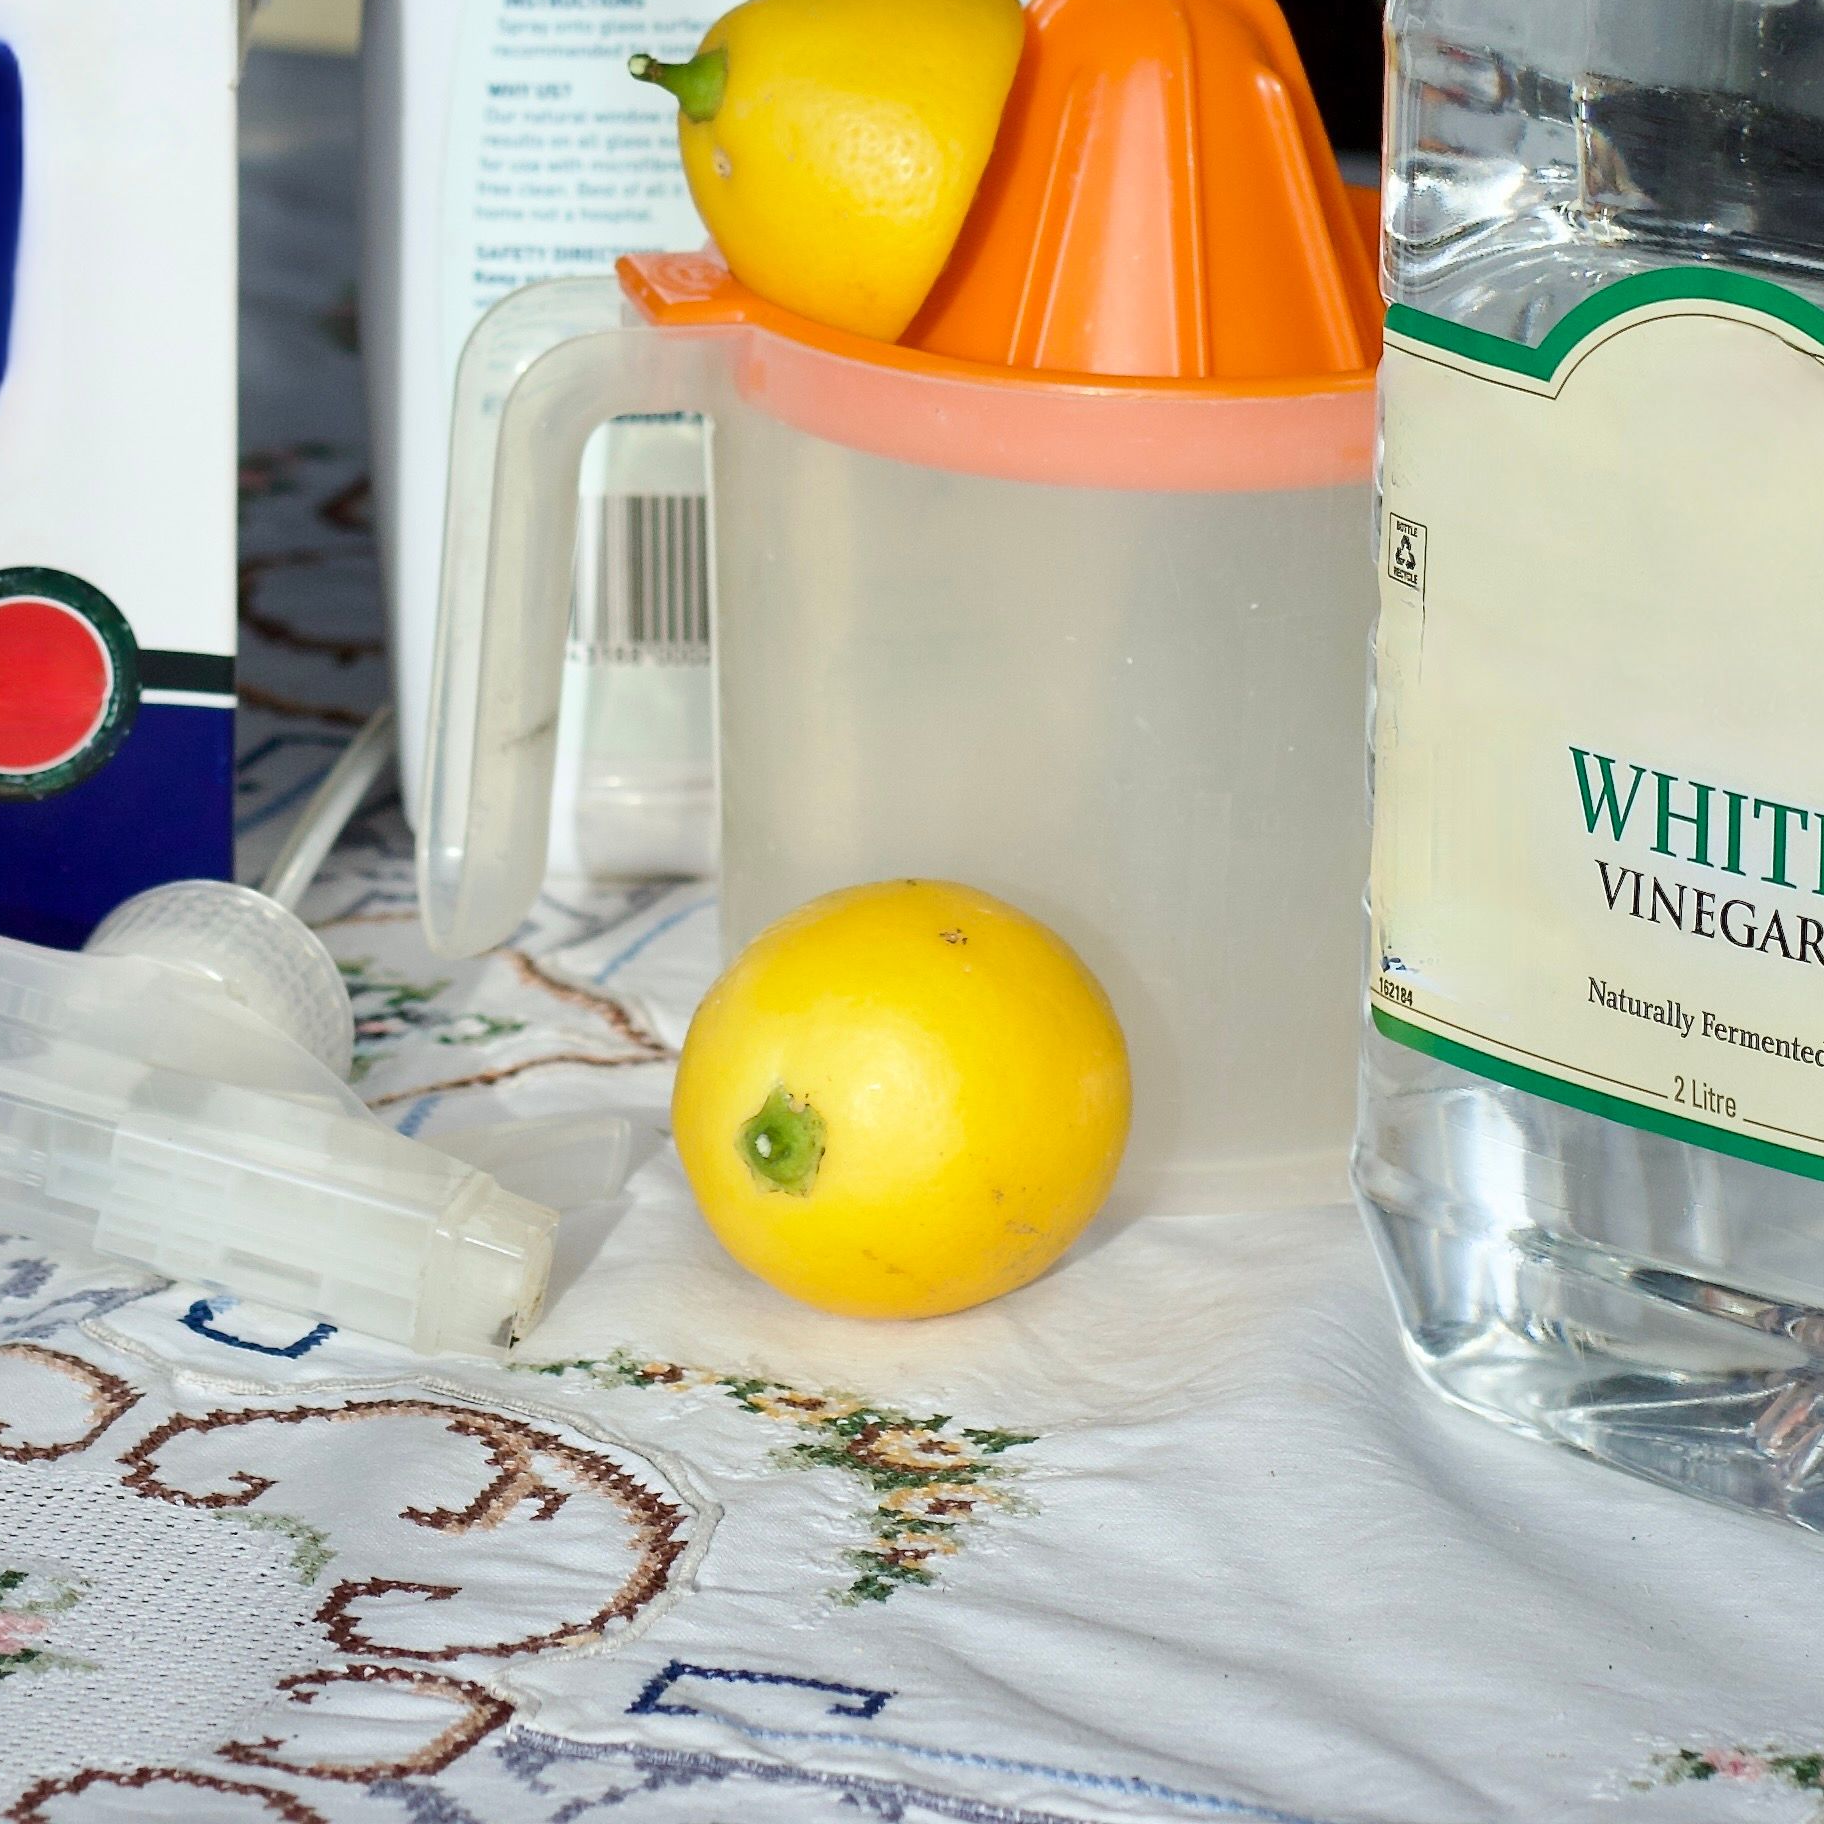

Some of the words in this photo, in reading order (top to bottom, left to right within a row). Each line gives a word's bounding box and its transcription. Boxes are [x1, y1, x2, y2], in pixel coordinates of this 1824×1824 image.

[488, 83, 529, 97] WHY
[535, 82, 573, 98] US?
[475, 245, 546, 260] SAFETY
[1396, 520, 1418, 538] BOTTLE
[1393, 566, 1418, 585] RECYCLE
[1587, 977, 1695, 1038] Naturally
[1674, 1075, 1686, 1104] 2
[1691, 1079, 1737, 1118] Litre
